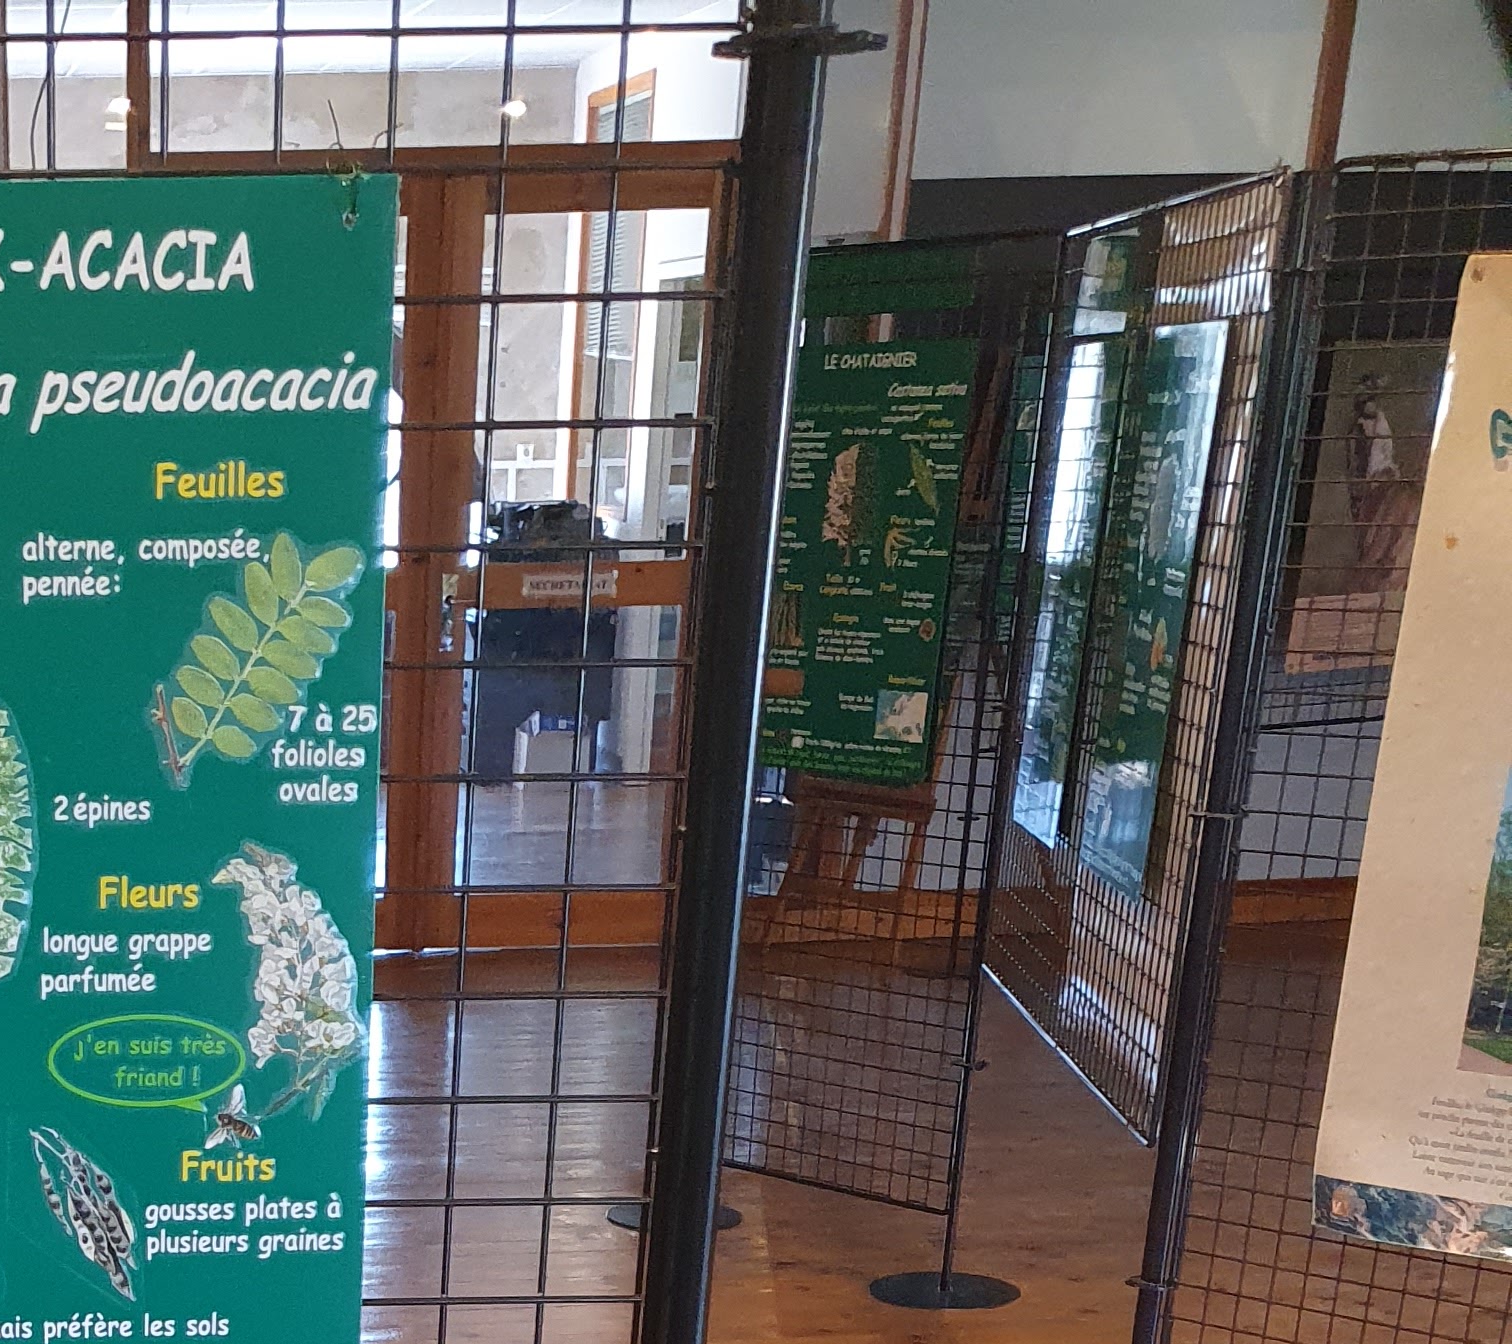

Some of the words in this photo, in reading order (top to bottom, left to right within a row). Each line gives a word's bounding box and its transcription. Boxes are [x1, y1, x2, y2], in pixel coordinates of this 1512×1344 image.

[28, 348, 379, 434] pseudoacacia
[154, 461, 286, 500] Feuilles
[22, 533, 125, 566] alterne,
[138, 528, 270, 568] composée,
[22, 566, 121, 604] pennée:
[288, 704, 306, 733] 7
[315, 704, 333, 732] à
[342, 705, 377, 733] 25
[271, 738, 365, 769] folioles
[280, 775, 359, 804] ovales
[53, 798, 70, 821] 2
[73, 794, 152, 828] épines
[98, 876, 200, 911] Fleurs
[42, 927, 118, 960] longue
[128, 931, 212, 961] grappe
[40, 964, 156, 1000] parfumée
[129, 1035, 171, 1056] suis
[181, 1034, 226, 1056] très
[115, 1066, 184, 1089] friand
[181, 1150, 276, 1183] Fruits
[145, 1200, 234, 1224] gousses
[245, 1195, 318, 1223] plates
[328, 1192, 343, 1219] à
[145, 1229, 249, 1260] plusieurs
[259, 1230, 345, 1264] graines
[143, 1313, 177, 1338] les
[186, 1312, 230, 1338] sols
